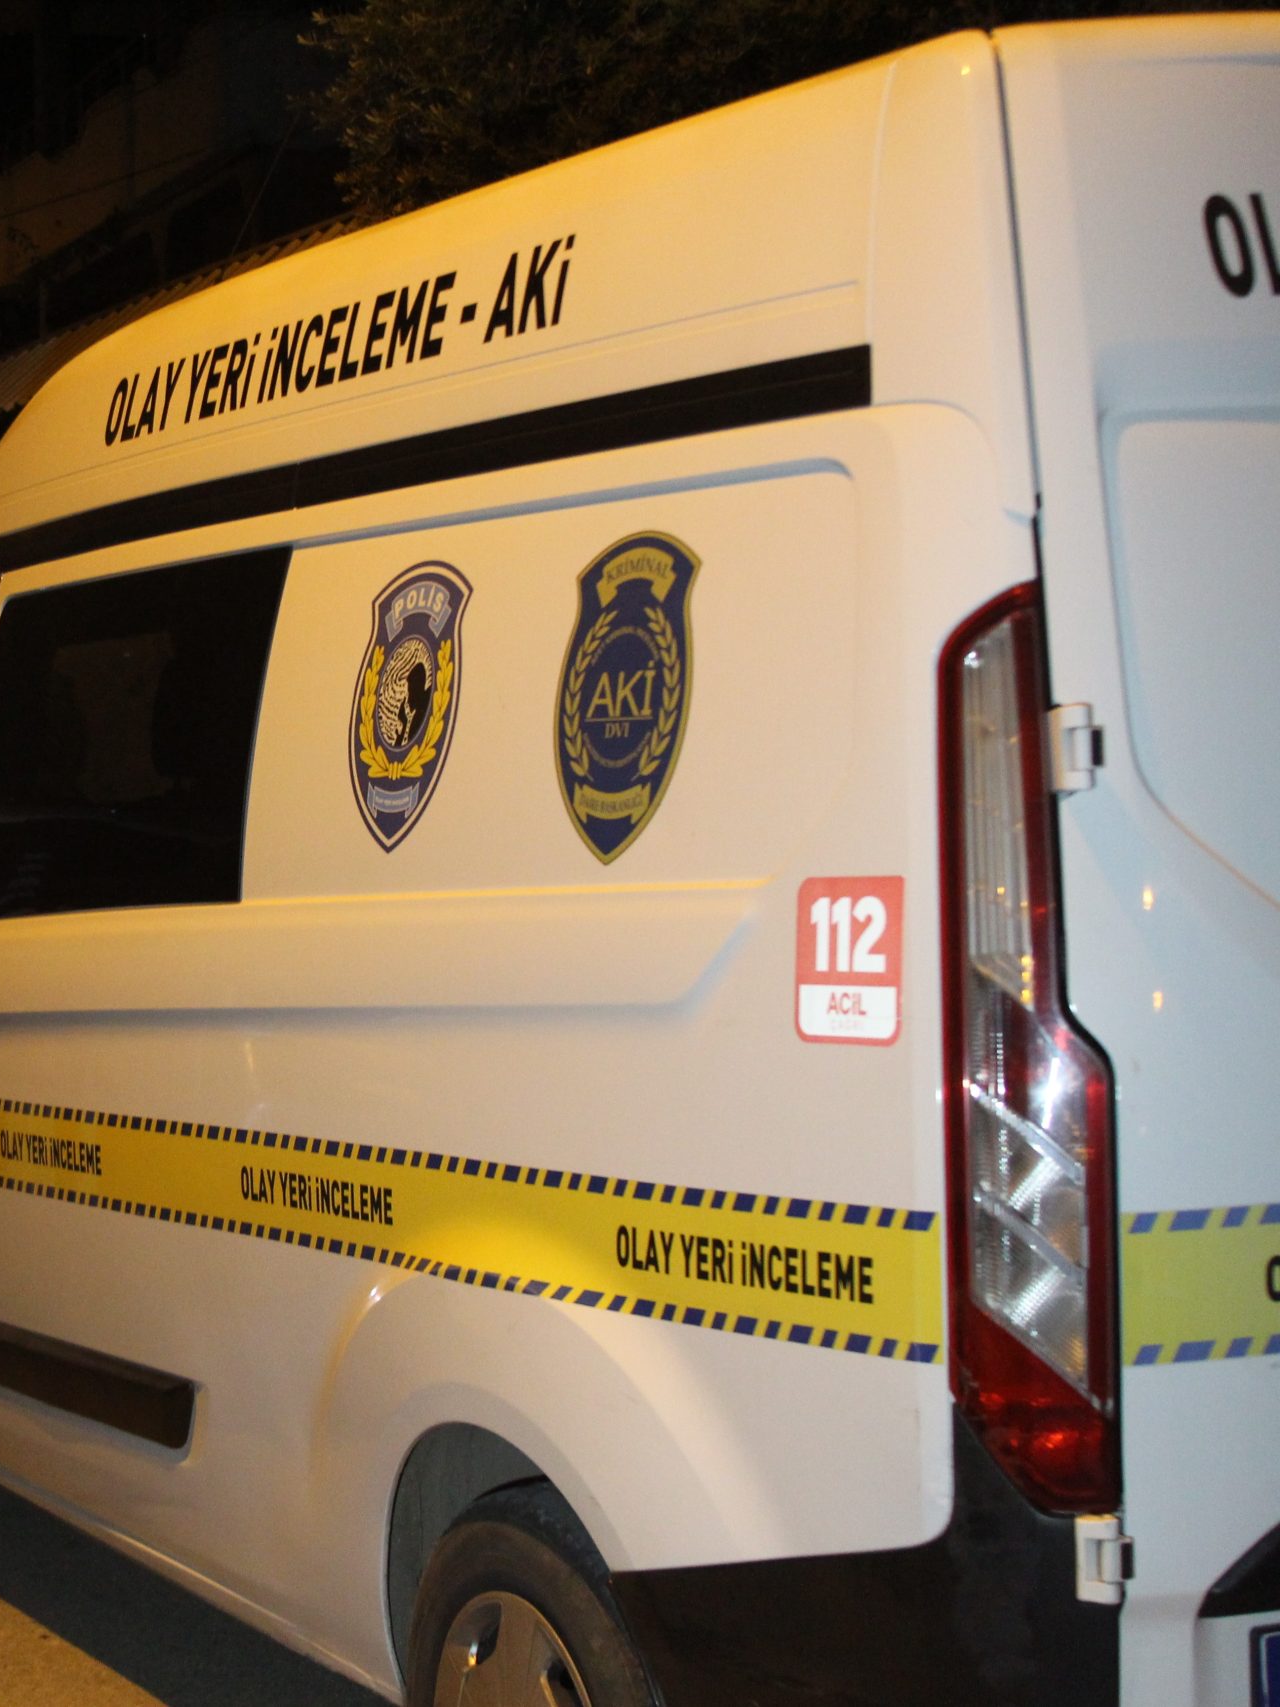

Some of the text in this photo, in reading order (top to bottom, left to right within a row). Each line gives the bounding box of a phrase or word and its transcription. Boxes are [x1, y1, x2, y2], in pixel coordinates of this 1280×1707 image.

[105, 357, 186, 447] OLAY
[810, 896, 887, 973] 112
[0, 1129, 24, 1161] OLAY
[241, 1166, 276, 1205] OLAY
[616, 1225, 674, 1275] OLAY
